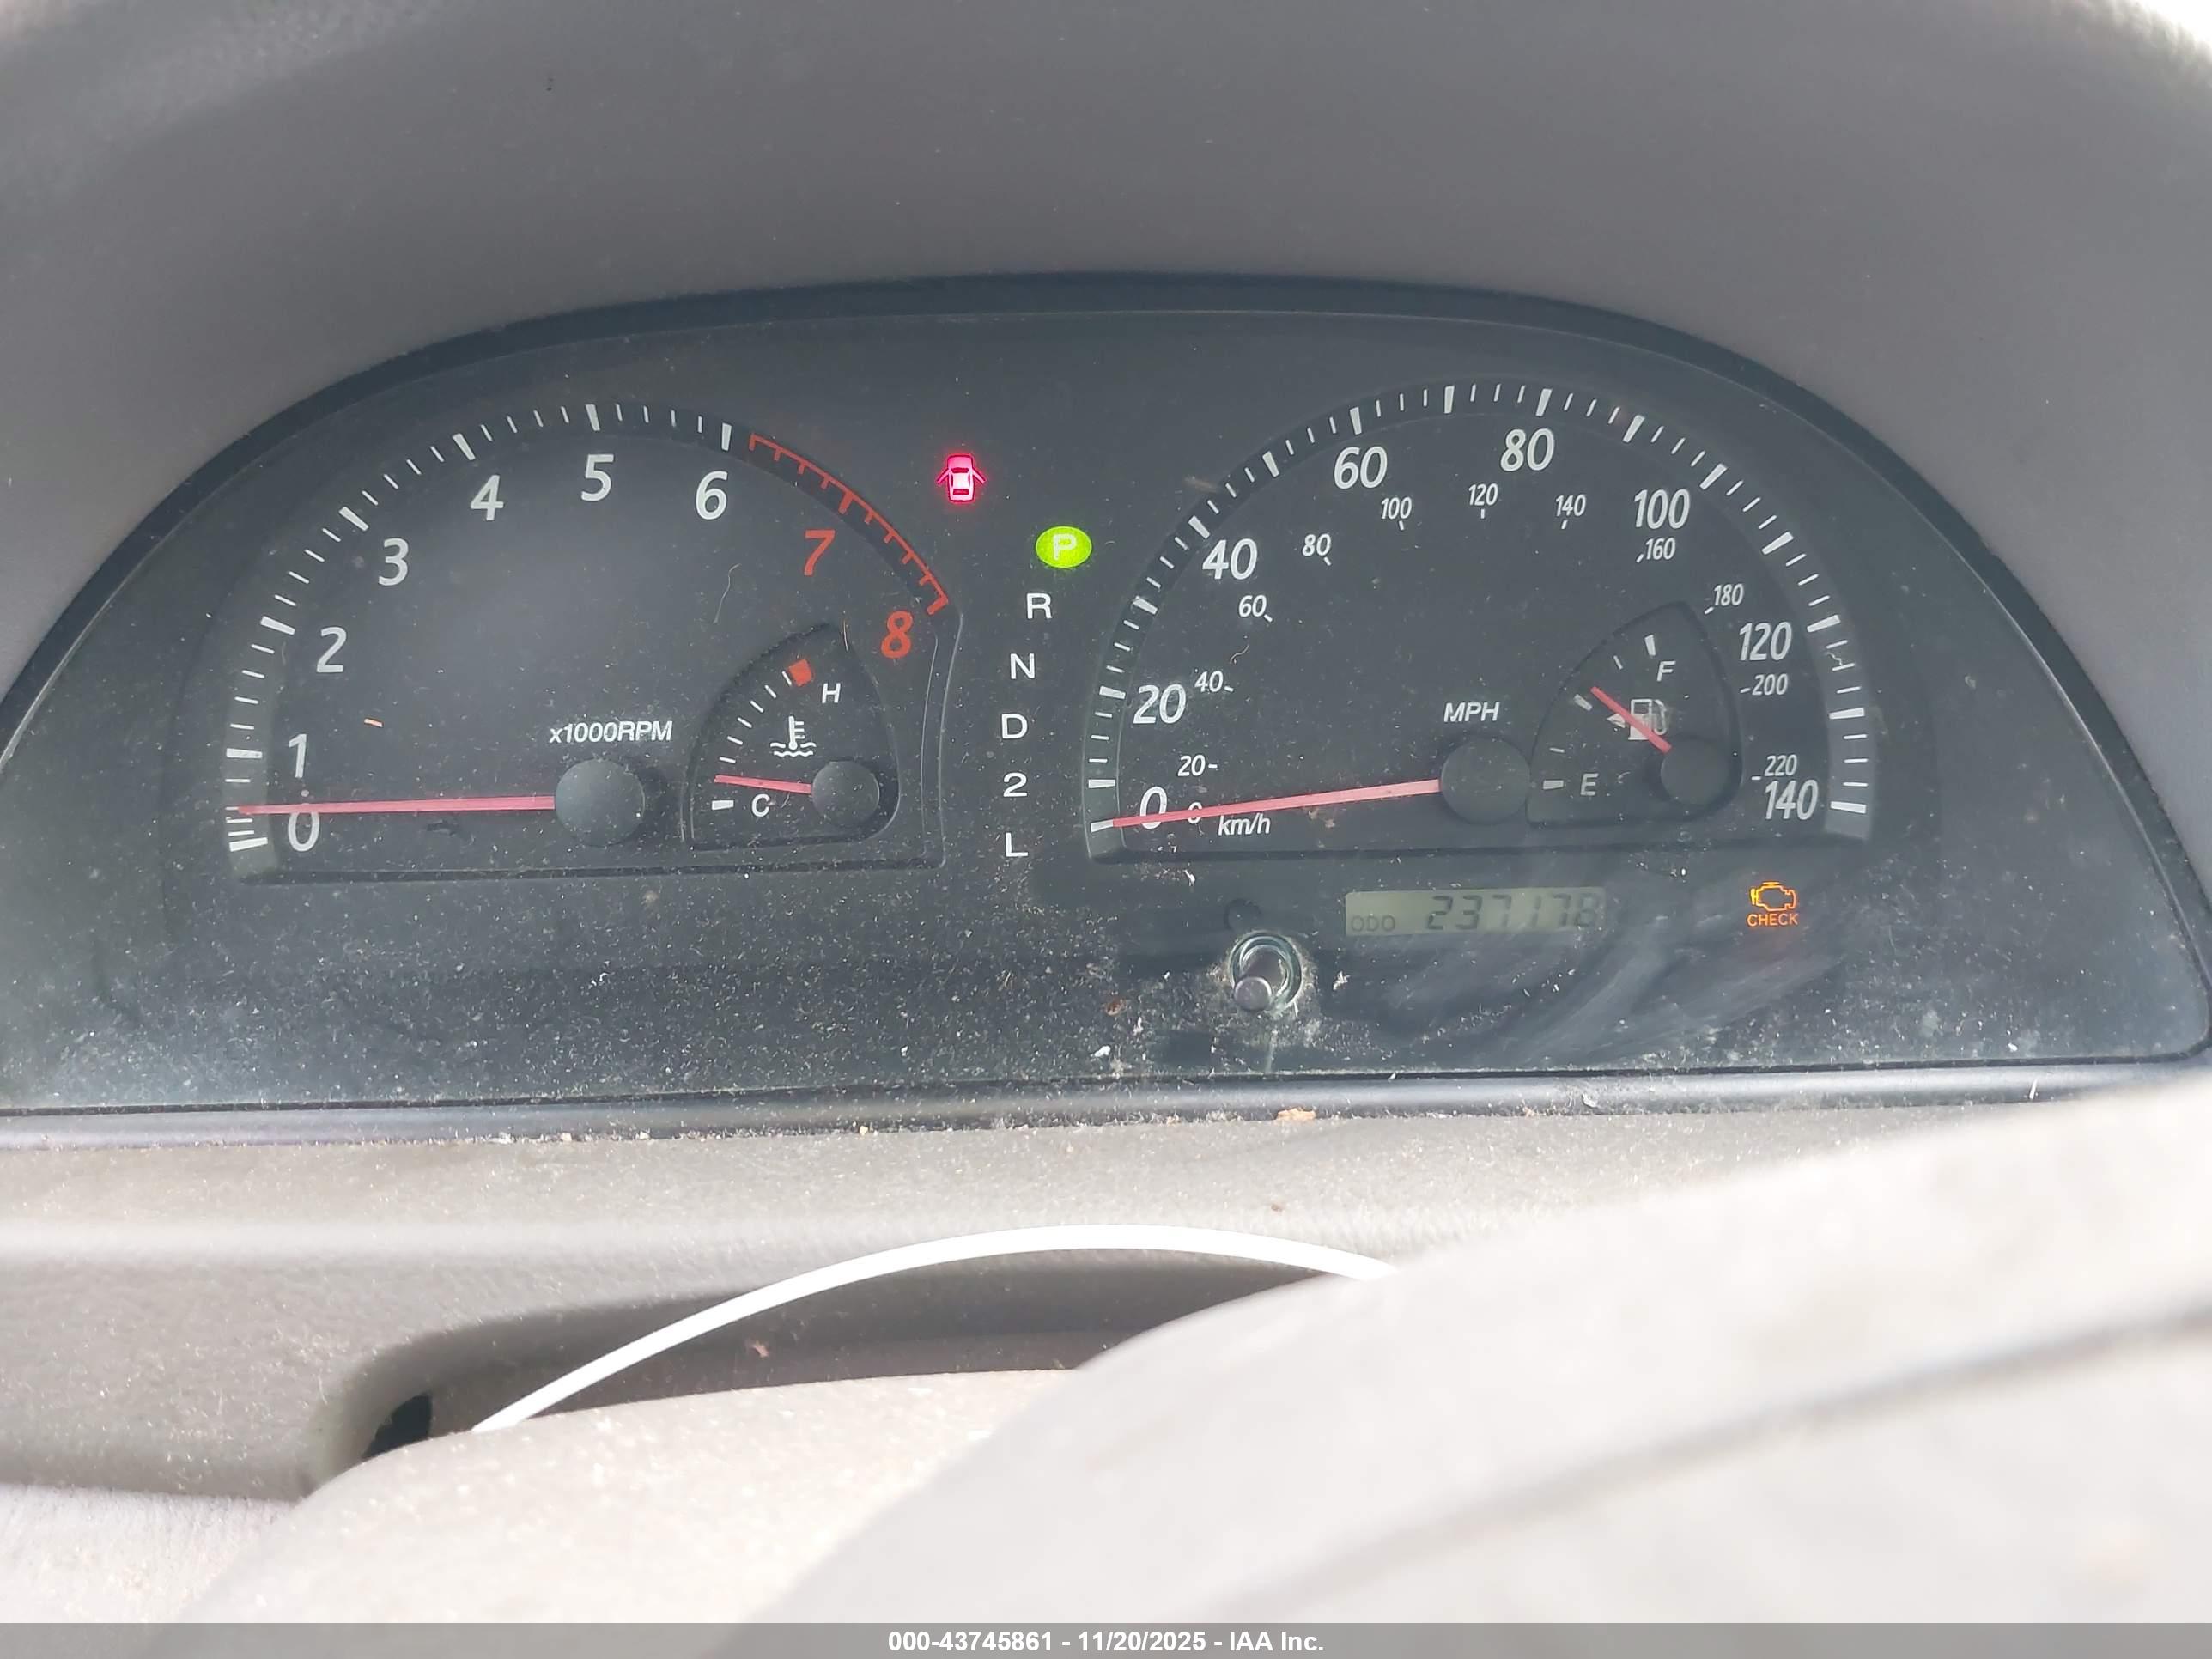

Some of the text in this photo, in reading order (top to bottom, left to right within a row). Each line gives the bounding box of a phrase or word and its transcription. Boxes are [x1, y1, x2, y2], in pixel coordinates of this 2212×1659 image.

[1500, 428, 1555, 471] 80
[580, 453, 615, 501] 5
[1333, 446, 1388, 489] 60
[470, 474, 505, 520] 4
[695, 471, 729, 520] 6
[1468, 483, 1499, 507] 120
[1555, 494, 1587, 517] 140
[1380, 496, 1413, 520] 100
[1633, 489, 1691, 530] 100
[804, 530, 836, 576] 7
[1052, 533, 1078, 560] P
[1302, 533, 1332, 556] 80
[1644, 538, 1676, 561] 160
[378, 538, 410, 586] 3
[1202, 538, 1257, 580] 40
[1027, 593, 1053, 618] R
[1238, 595, 1267, 617] 60
[1713, 583, 1745, 607] 180
[880, 611, 913, 659] 8
[1739, 622, 1792, 661] 120
[316, 627, 347, 673] 2
[1009, 653, 1036, 679] N
[1656, 660, 1676, 682] F
[822, 683, 842, 704] H
[1194, 671, 1224, 693] 40
[1752, 673, 1789, 697] 200
[1133, 684, 1187, 724] 20
[1443, 702, 1500, 722] MPH
[549, 720, 673, 744] x1000RPM
[1002, 714, 1029, 738] D
[288, 733, 307, 778] 1
[1177, 754, 1206, 777] 20
[1765, 754, 1798, 777] 220
[1002, 773, 1029, 798] 2
[1579, 774, 1598, 796] E
[751, 793, 771, 817] C
[1139, 786, 1168, 830] 0
[1764, 779, 1819, 820] 140
[1187, 801, 1203, 824] 0
[287, 805, 320, 853] 0
[1218, 815, 1271, 836] km/h
[1005, 832, 1028, 857] L
[1350, 892, 1600, 933] ODO 237178
[1747, 912, 1798, 927] CHECK
